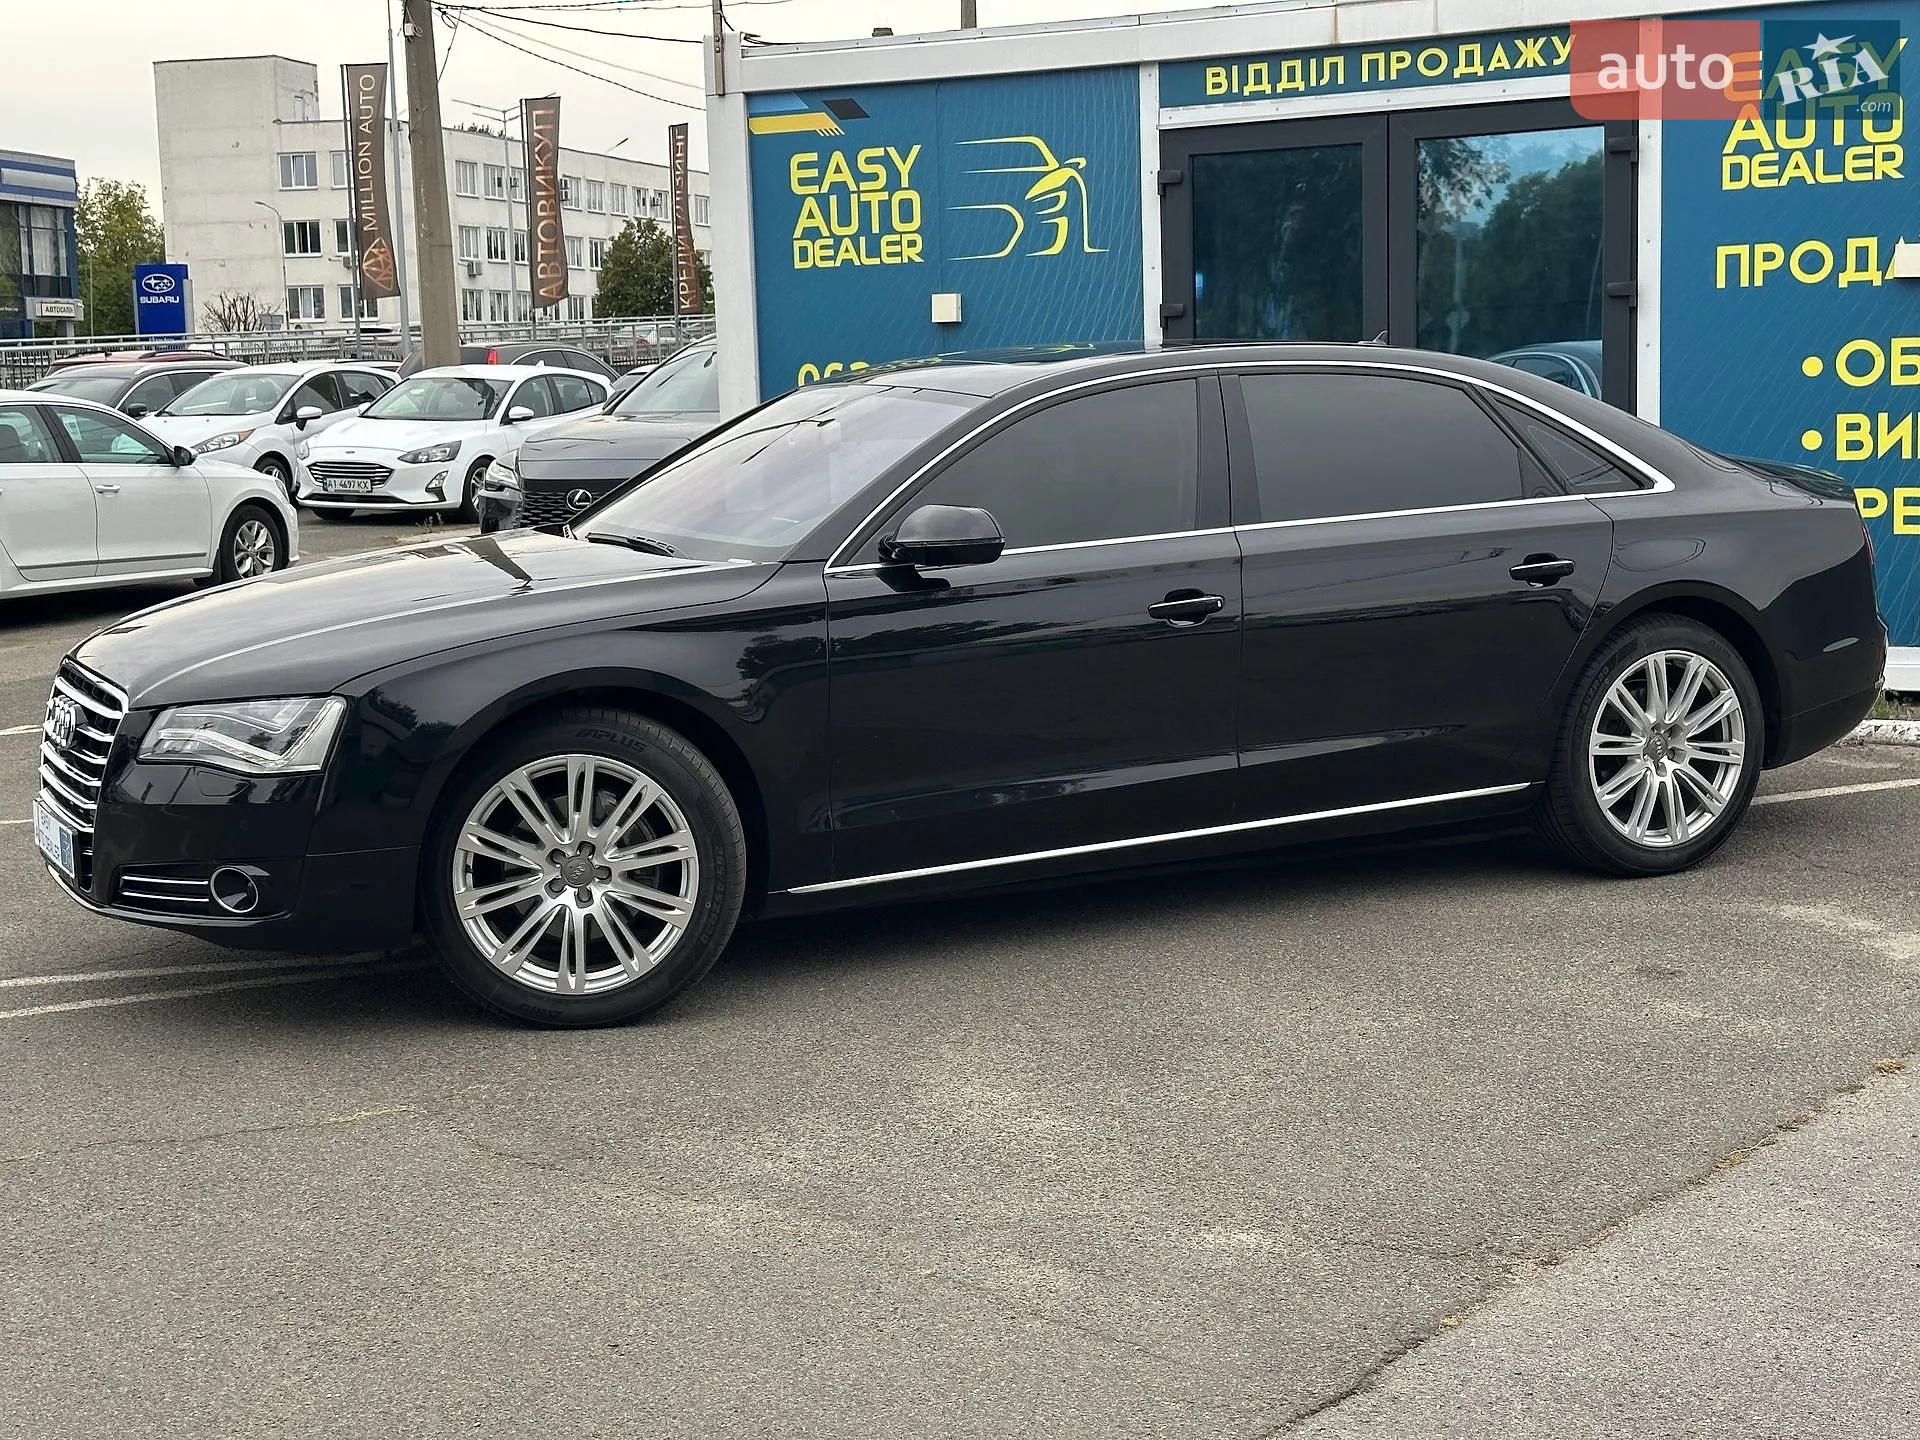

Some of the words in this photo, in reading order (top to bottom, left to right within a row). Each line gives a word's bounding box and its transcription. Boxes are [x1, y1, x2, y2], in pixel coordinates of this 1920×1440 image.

[1205, 55, 1345, 96] ВІДДІЛ
[1360, 34, 1577, 83] ПРОДАЖУ
[359, 73, 377, 135] AUTO
[1722, 93, 1905, 154] AUTO
[358, 142, 379, 232] MILLION
[789, 144, 922, 195] EASY
[1721, 143, 1906, 191] DEALER
[531, 107, 565, 301] АВТОВИКУП
[792, 188, 922, 239] AUTO
[792, 233, 925, 270] DEALER
[1715, 236, 1905, 289] ПРОД
[140, 295, 180, 304] SUBARU
[1836, 412, 1920, 461] ВИ
[339, 479, 356, 490] 4697
